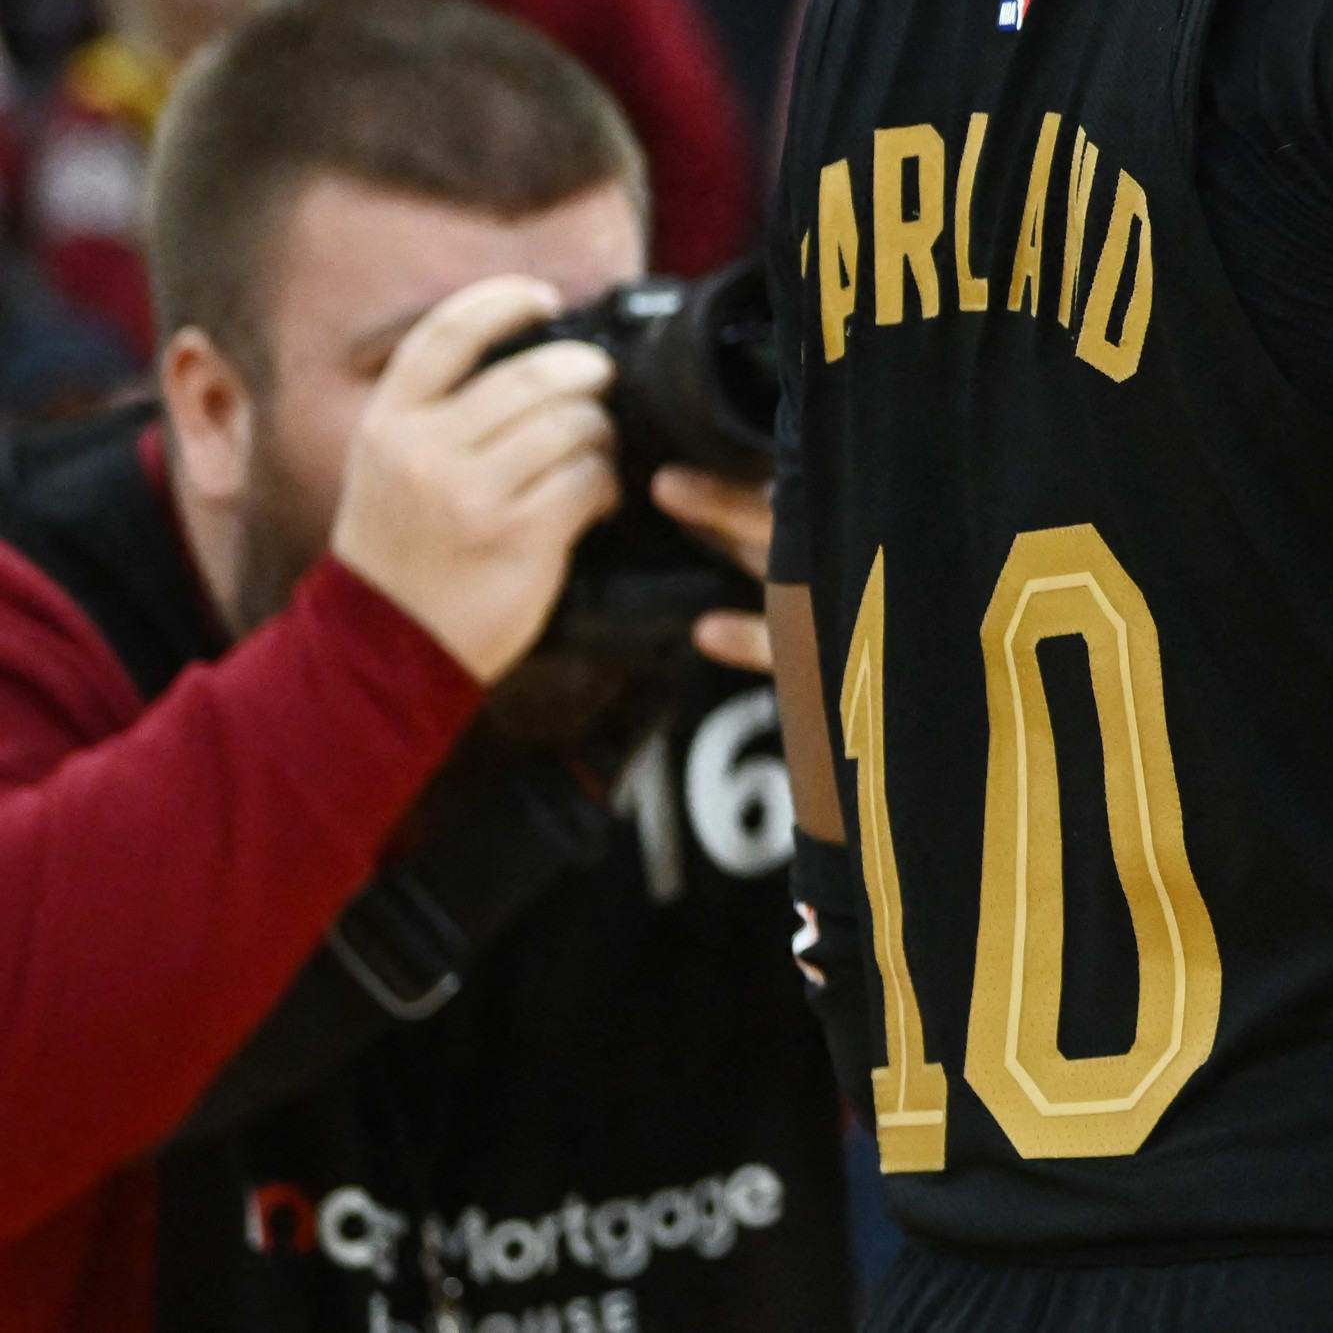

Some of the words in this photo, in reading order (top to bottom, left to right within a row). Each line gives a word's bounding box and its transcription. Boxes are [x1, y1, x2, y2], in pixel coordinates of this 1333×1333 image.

[800, 112, 1154, 384] ARLAND
[606, 686, 796, 904] 16
[840, 522, 1223, 1174] 10
